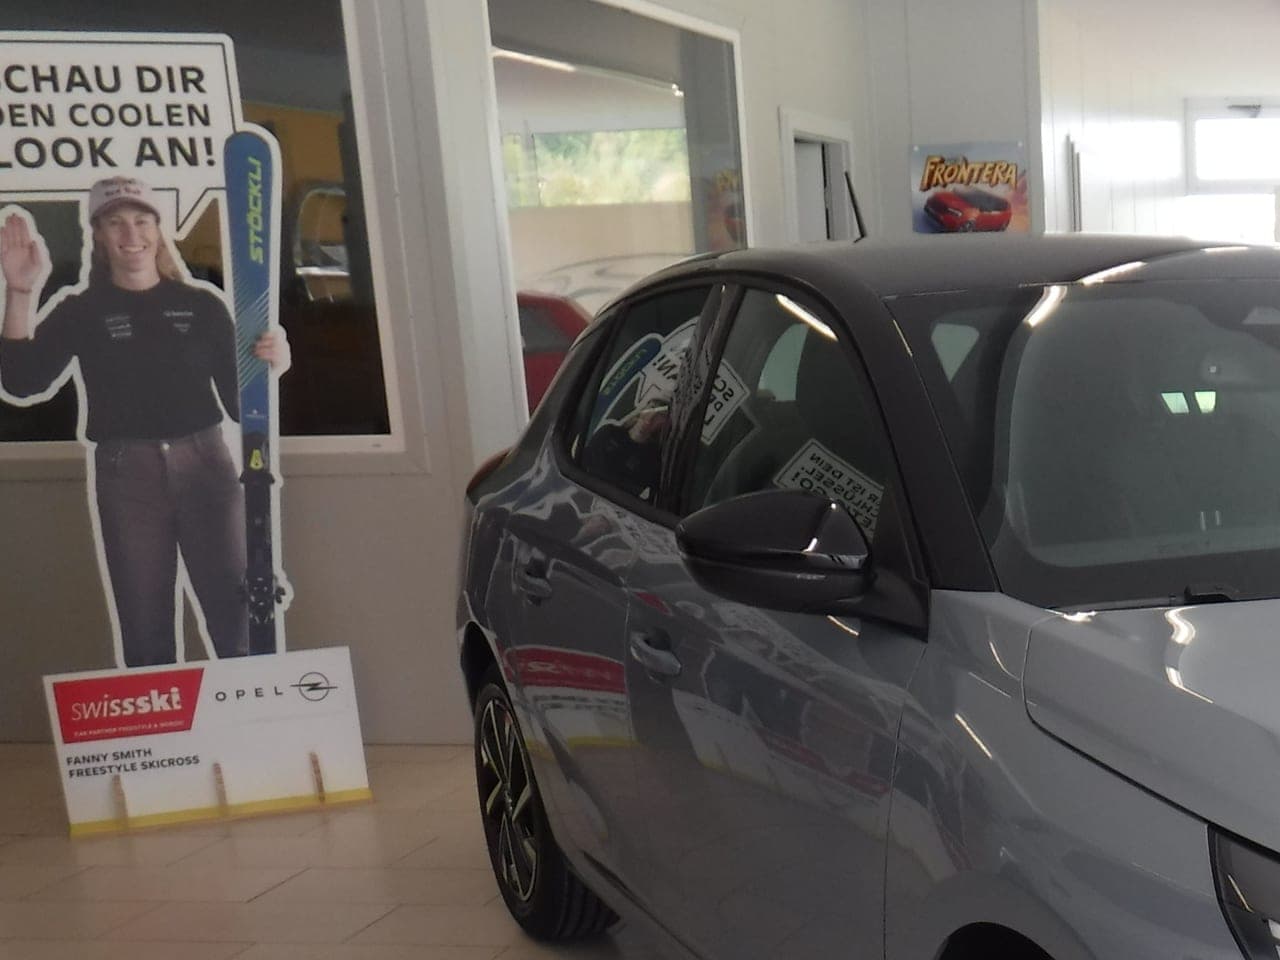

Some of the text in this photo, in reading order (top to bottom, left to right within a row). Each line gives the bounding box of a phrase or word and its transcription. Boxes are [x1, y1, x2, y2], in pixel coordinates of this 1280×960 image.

[0, 64, 207, 94] CHAU DIR
[0, 103, 211, 127] EN COOLEN
[135, 137, 216, 168] AN!
[919, 154, 1018, 192] FRONTERA
[71, 687, 182, 721] swissski
[215, 685, 284, 702] OPEL
[66, 748, 152, 766] FANNY SMITH
[68, 755, 200, 778] FREESTYLE SKICROSS
